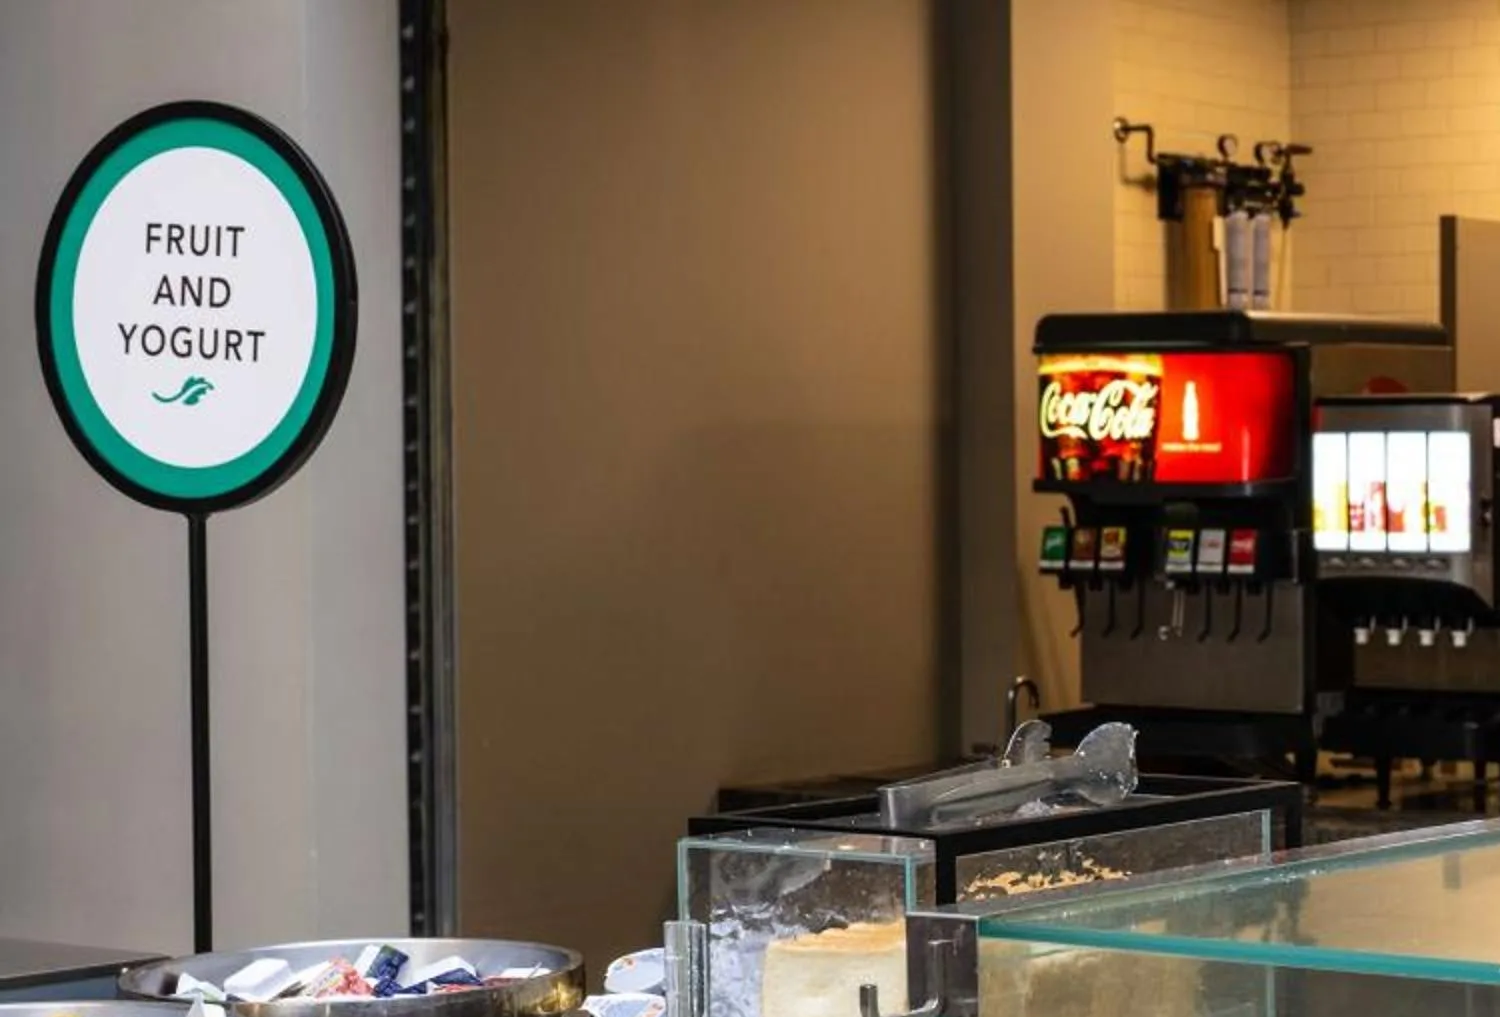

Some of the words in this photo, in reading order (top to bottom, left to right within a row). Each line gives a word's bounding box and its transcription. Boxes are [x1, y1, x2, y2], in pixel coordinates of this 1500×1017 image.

[145, 223, 245, 257] FRUIT
[153, 274, 231, 308] AND
[118, 323, 265, 362] YOGURT
